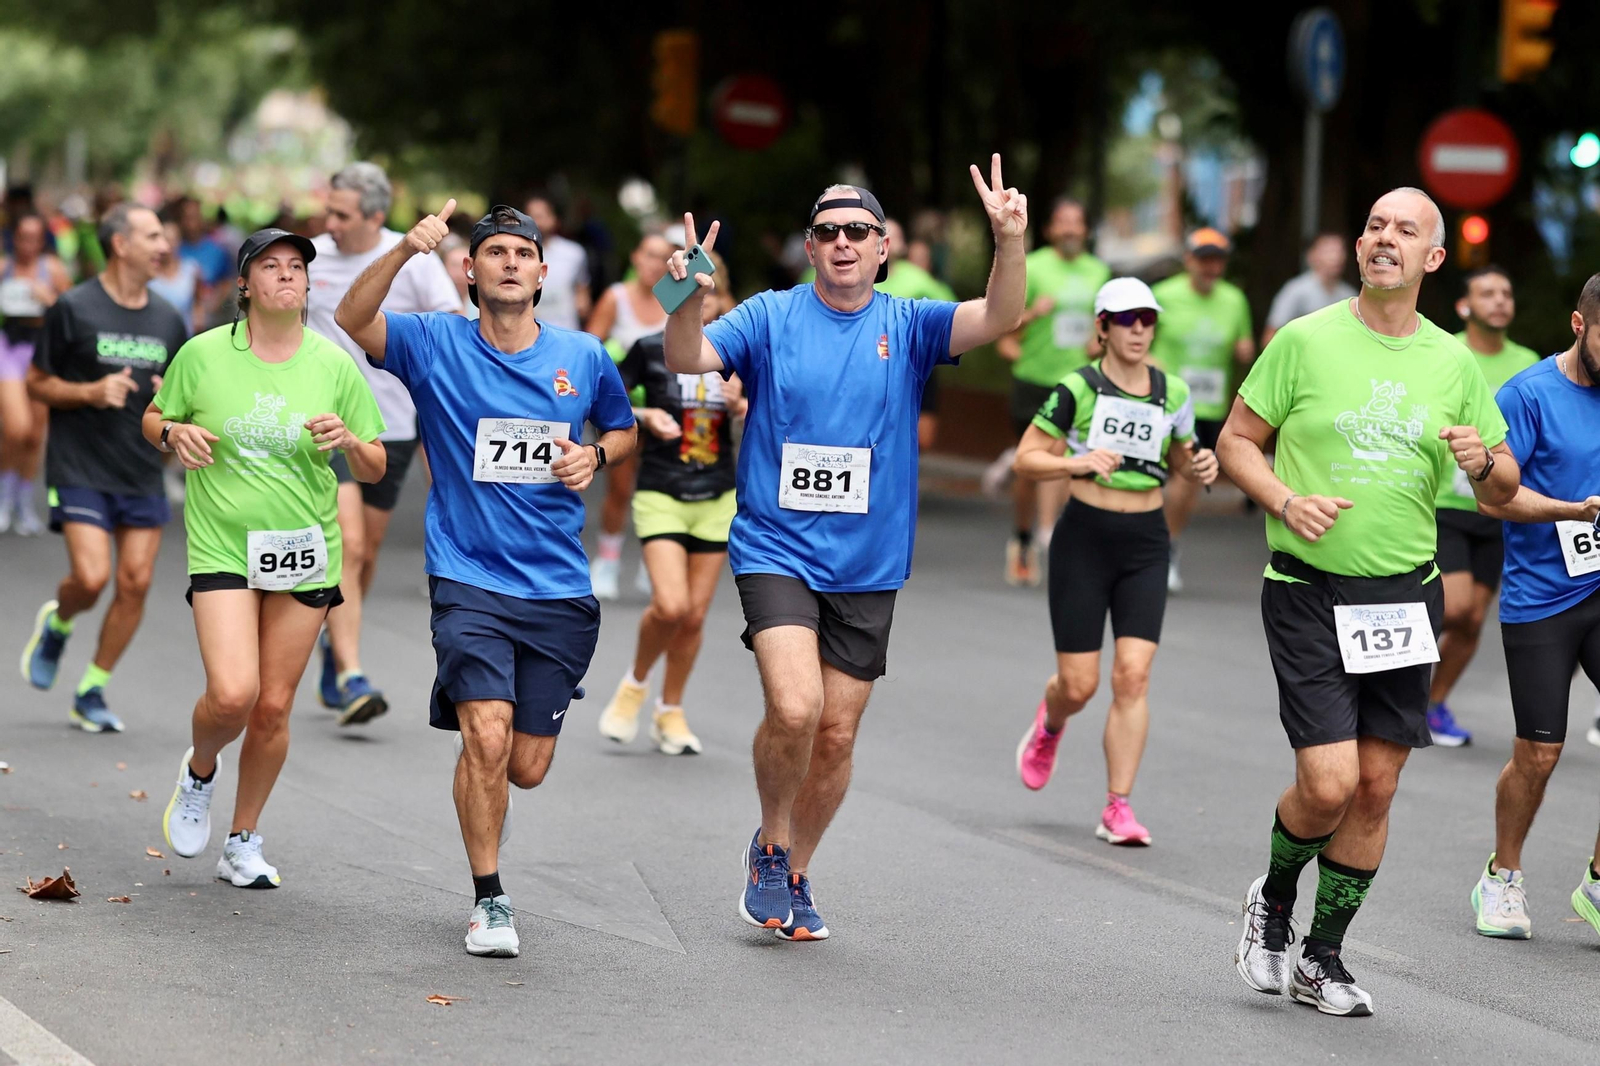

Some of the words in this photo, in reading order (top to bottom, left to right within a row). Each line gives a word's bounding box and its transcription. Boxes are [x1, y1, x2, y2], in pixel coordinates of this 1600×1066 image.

[97, 338, 168, 363] CHICAGO
[1103, 417, 1152, 441] 643
[1334, 411, 1408, 434] Carrera
[489, 440, 552, 464] 714
[792, 467, 851, 492] 881
[259, 548, 315, 573] 945
[1351, 627, 1412, 652] 137
